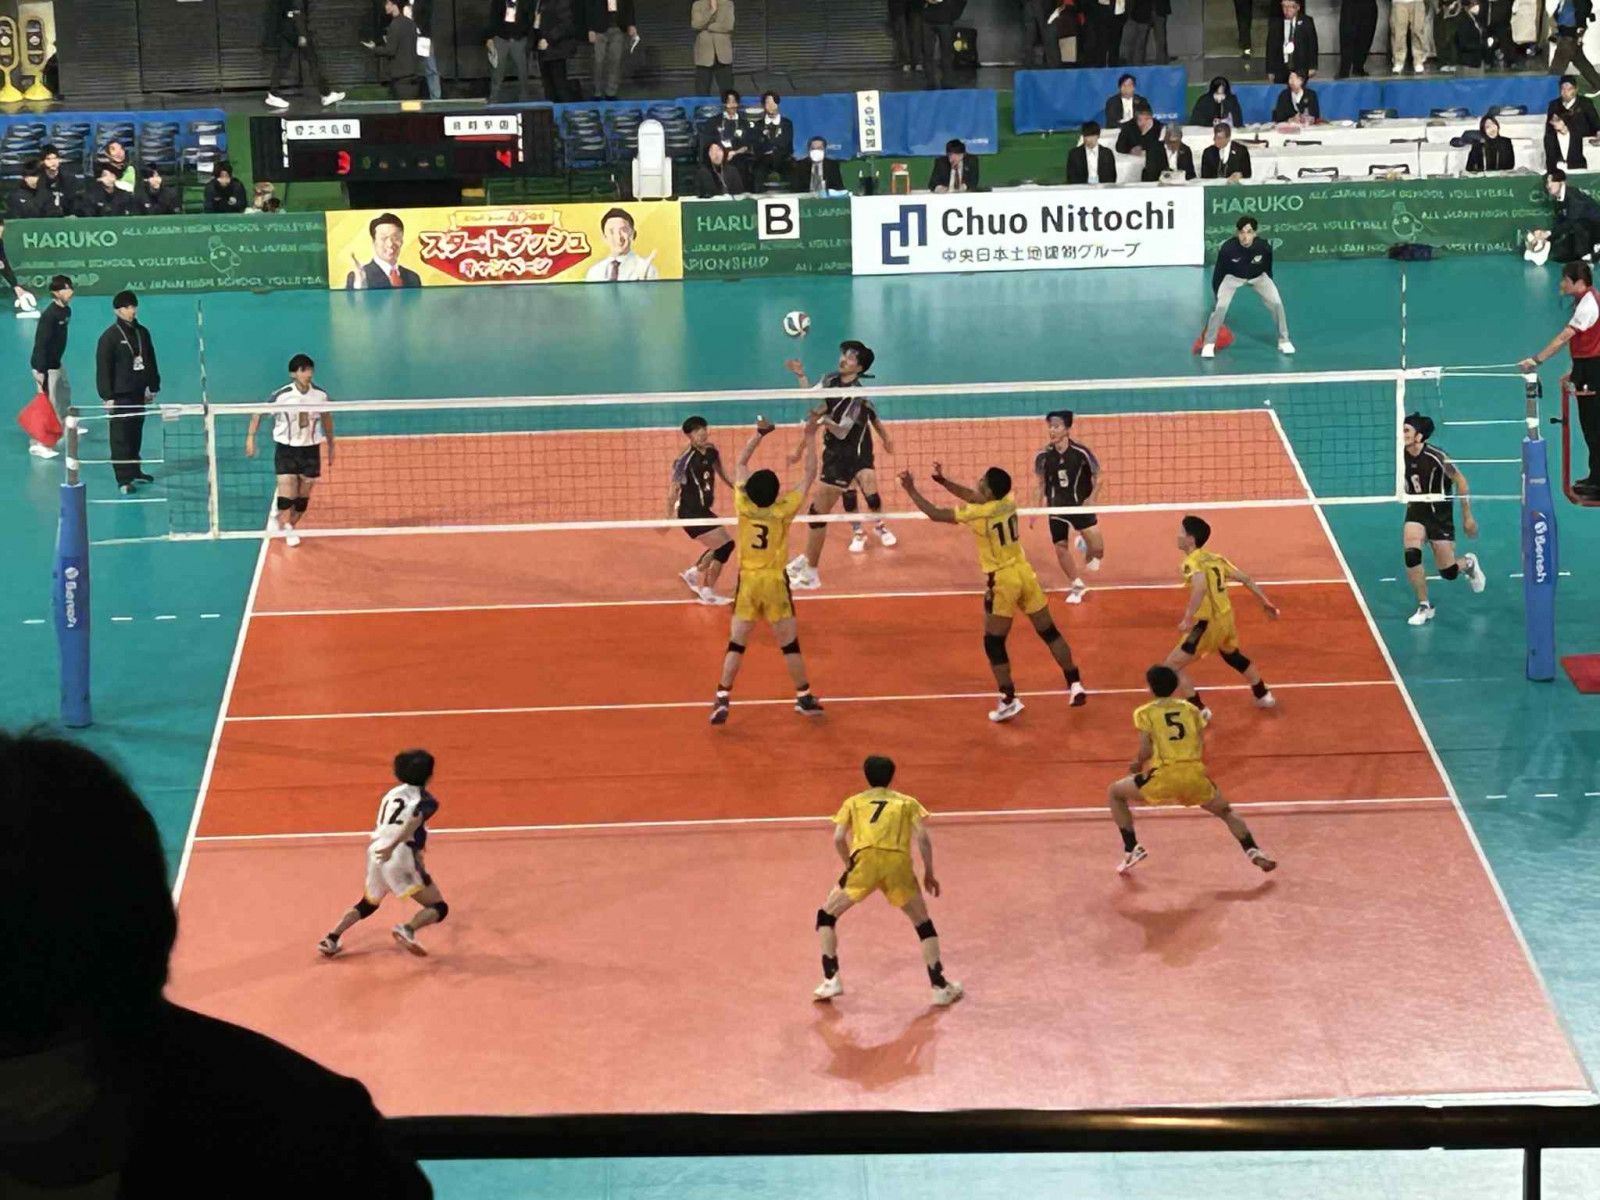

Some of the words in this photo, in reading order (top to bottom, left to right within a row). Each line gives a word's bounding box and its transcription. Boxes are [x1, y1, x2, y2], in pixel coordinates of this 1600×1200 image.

[1212, 195, 1304, 214] HARUKO
[697, 215, 757, 231] HARU
[765, 203, 794, 235] B
[942, 207, 1028, 237] Chuo
[1041, 201, 1175, 233] Nittochi
[22, 230, 119, 249] HARUKO
[751, 523, 769, 550] 3
[993, 513, 1019, 546] 10
[1165, 711, 1185, 741] 5
[380, 797, 405, 825] 12
[870, 800, 888, 824] 7
